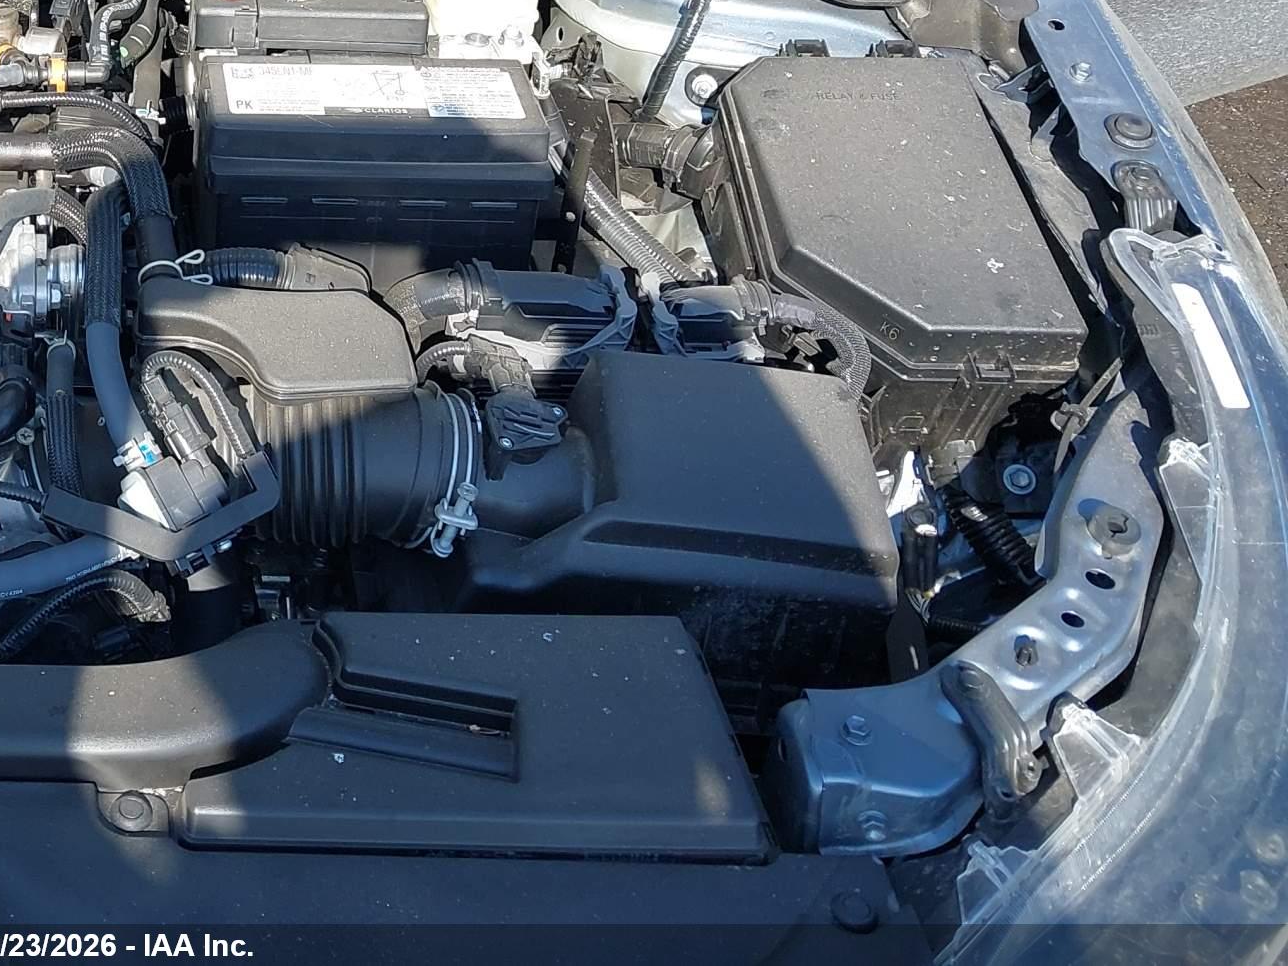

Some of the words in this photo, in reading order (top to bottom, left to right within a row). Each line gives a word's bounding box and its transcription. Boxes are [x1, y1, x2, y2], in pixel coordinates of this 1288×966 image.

[236, 99, 253, 110] PK
[364, 107, 409, 115] CLARIOS
[879, 321, 900, 340] K6
